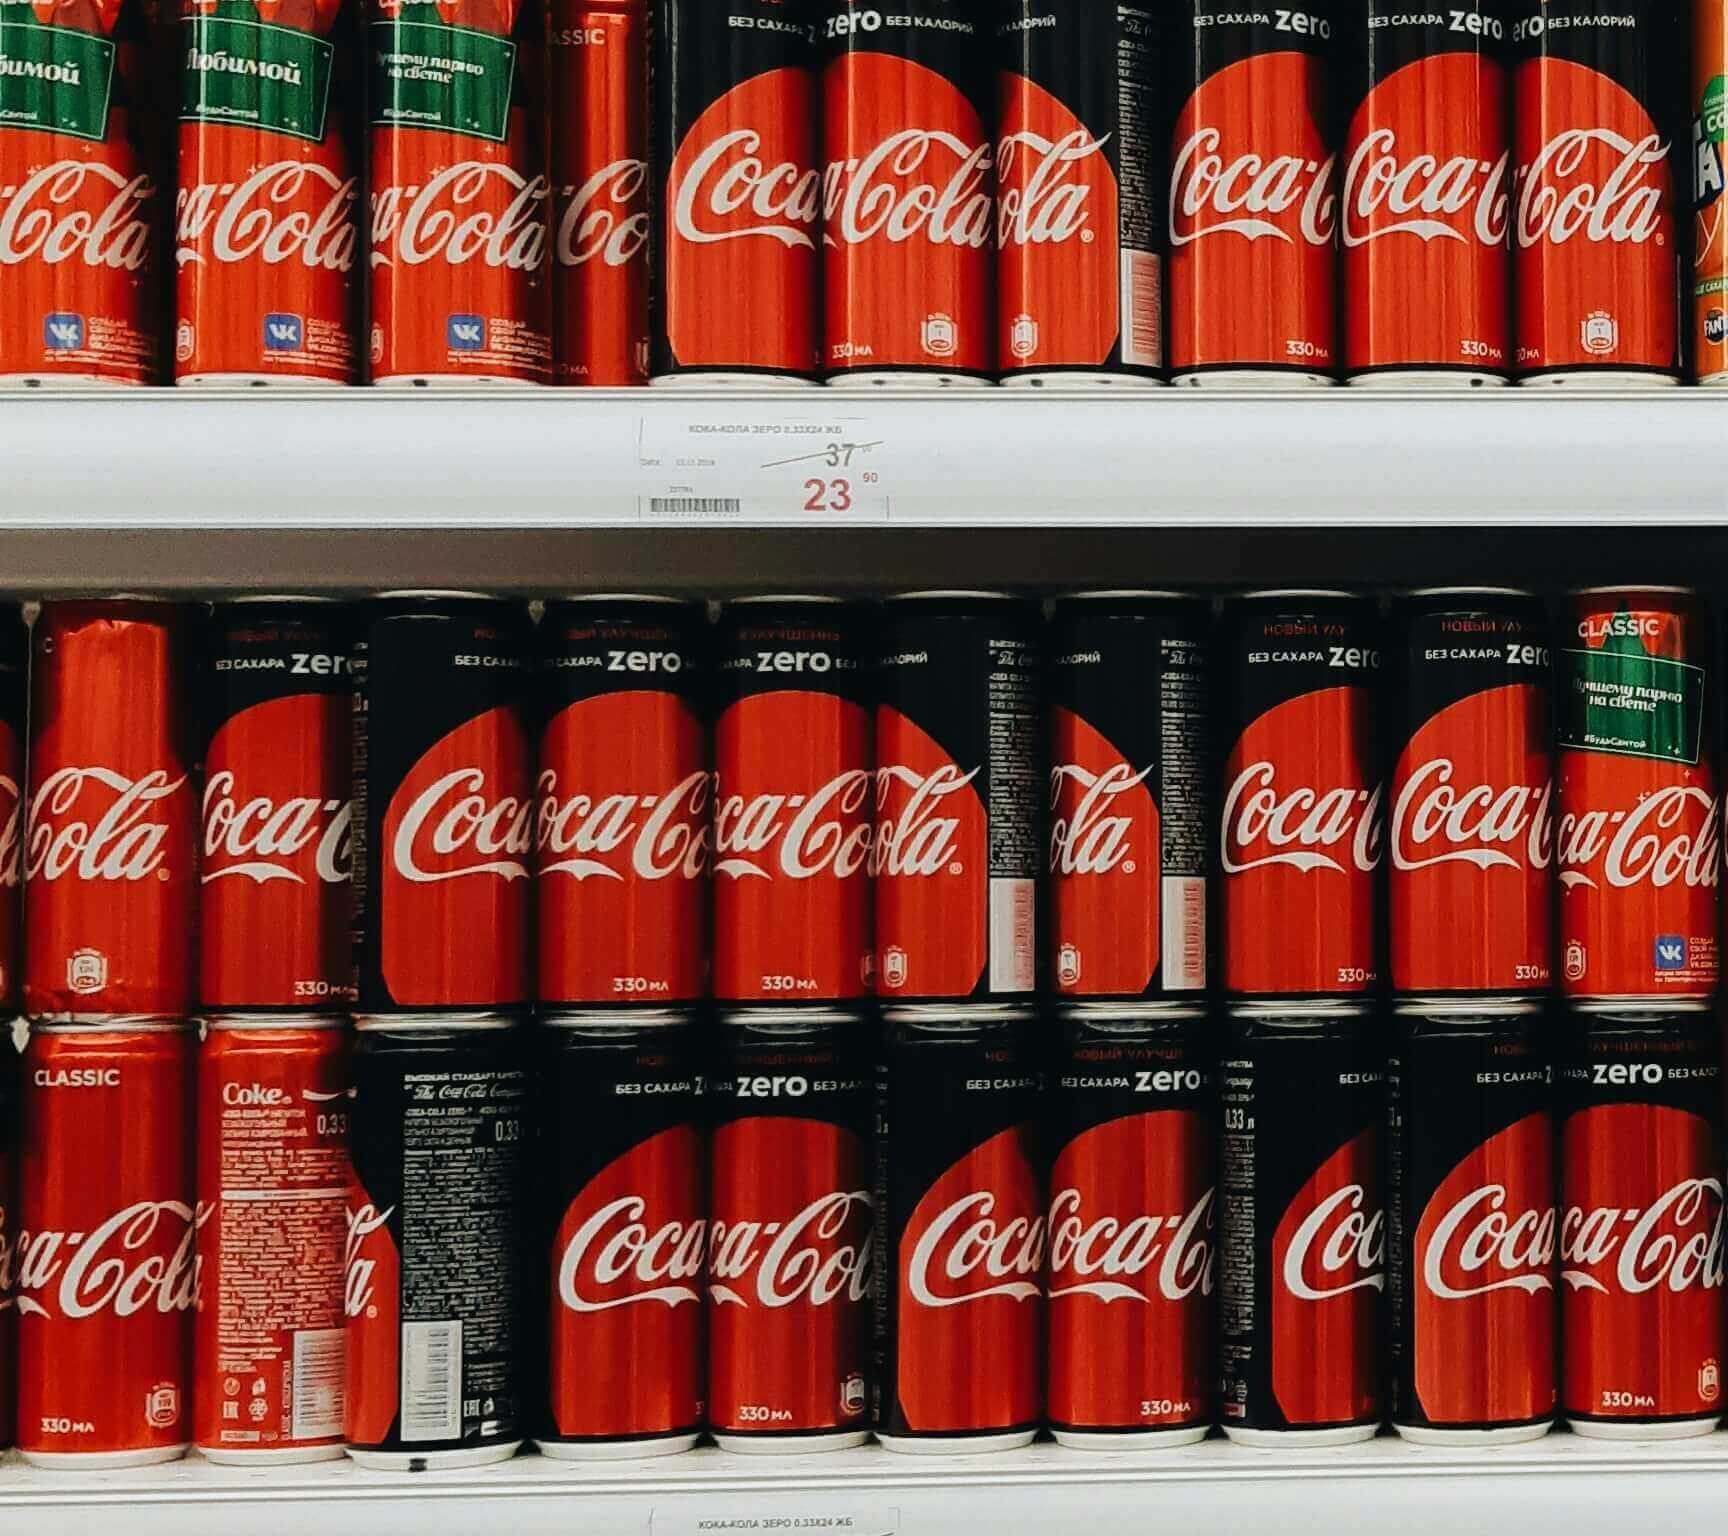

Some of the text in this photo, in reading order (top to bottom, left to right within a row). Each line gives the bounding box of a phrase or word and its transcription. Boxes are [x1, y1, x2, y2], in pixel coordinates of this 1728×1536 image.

[827, 10, 881, 38] zero
[886, 16, 911, 26] БЕЗ
[1217, 14, 1269, 25] САХАРА
[1274, 10, 1330, 40] zero
[1391, 15, 1443, 26] САХАРА
[1449, 10, 1502, 40] zero
[1549, 14, 1635, 29] БЕЗ КАЛОРИЙ
[825, 443, 854, 466] 37
[804, 472, 878, 511] 23 90
[1578, 620, 1659, 639] CLASSIC
[607, 649, 682, 673] zero
[757, 649, 831, 672] zero
[1249, 652, 1323, 663] БЕЗ САХАРА
[1425, 648, 1501, 660] БЕЗ САХАРА
[613, 976, 648, 992] 330
[761, 975, 796, 991] 330
[34, 1068, 120, 1088] CLASSIC
[1134, 1070, 1200, 1093] zero
[1593, 1064, 1662, 1085] zero
[1603, 1392, 1636, 1407] 330
